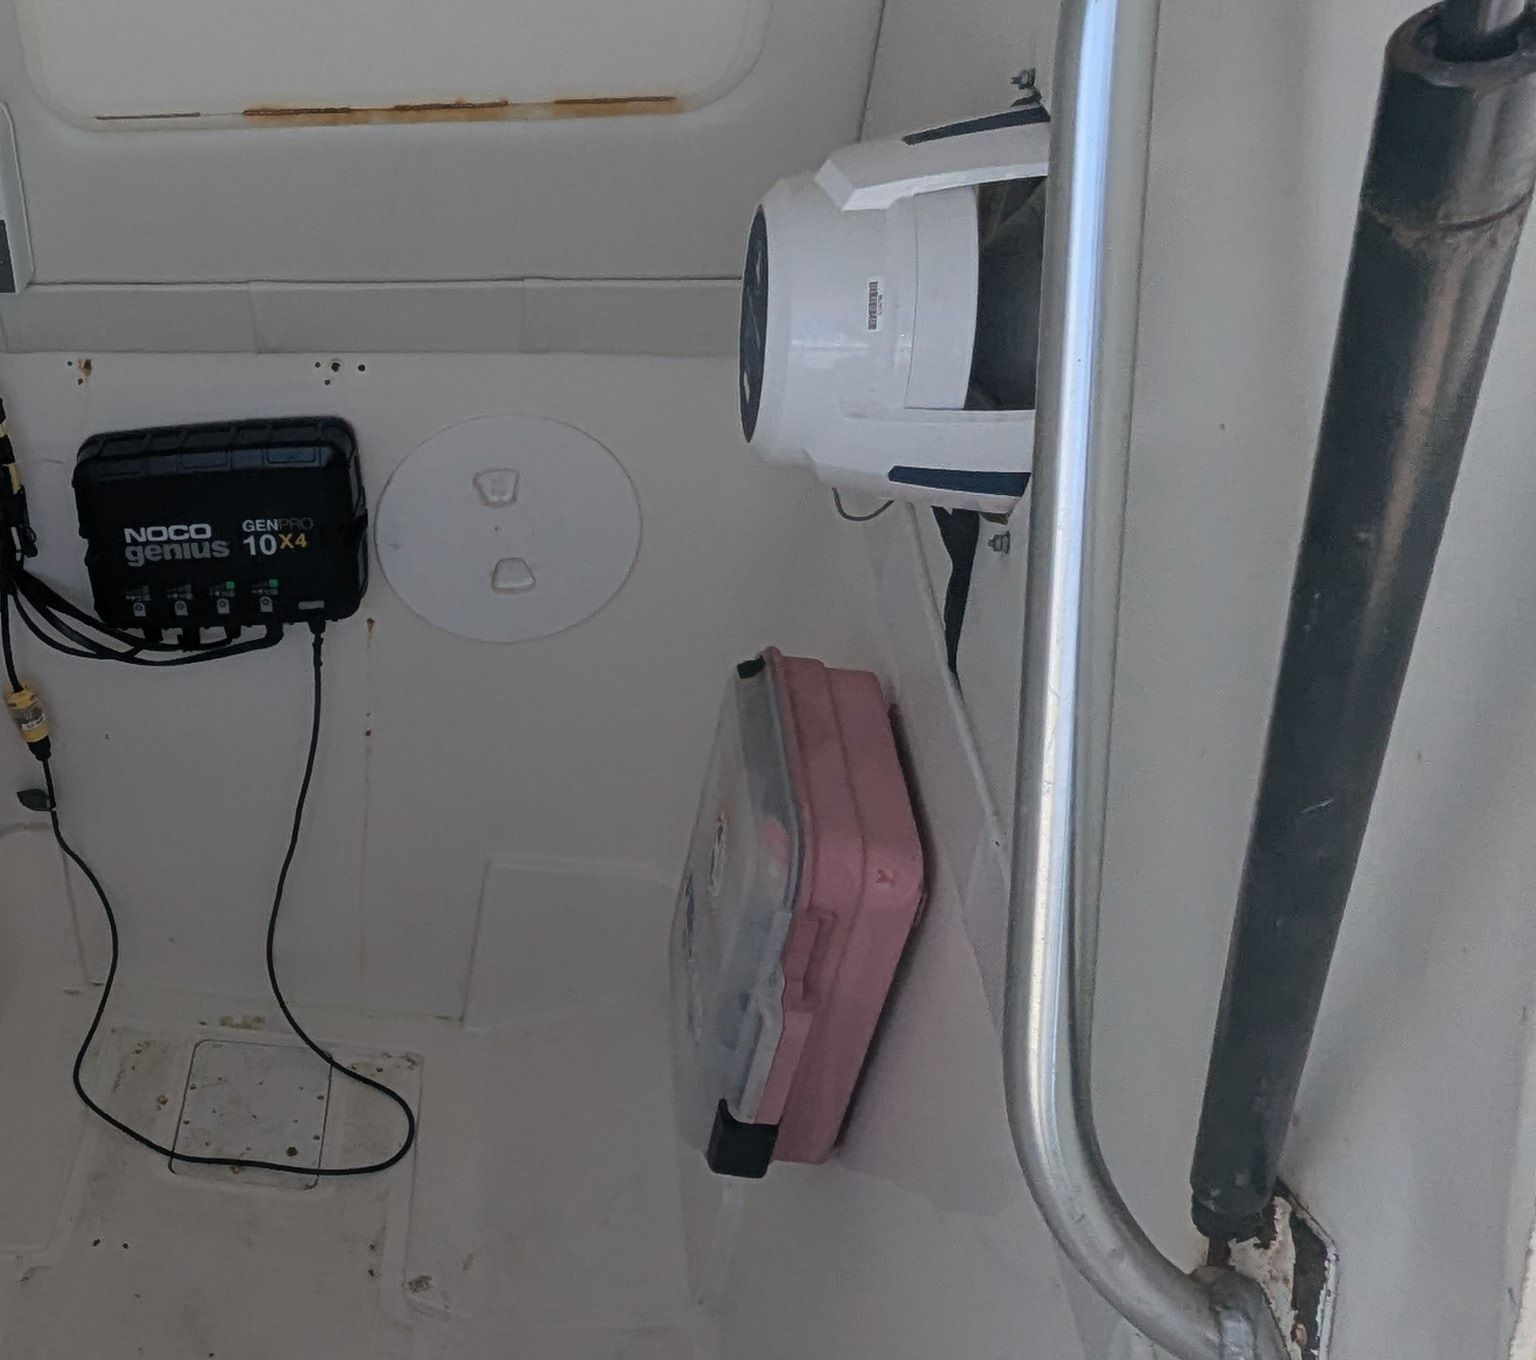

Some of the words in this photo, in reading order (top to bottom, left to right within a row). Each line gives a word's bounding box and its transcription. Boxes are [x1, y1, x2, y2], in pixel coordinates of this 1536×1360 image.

[124, 522, 212, 543] NOCO
[242, 517, 314, 533] GENPRO
[125, 539, 230, 568] genius
